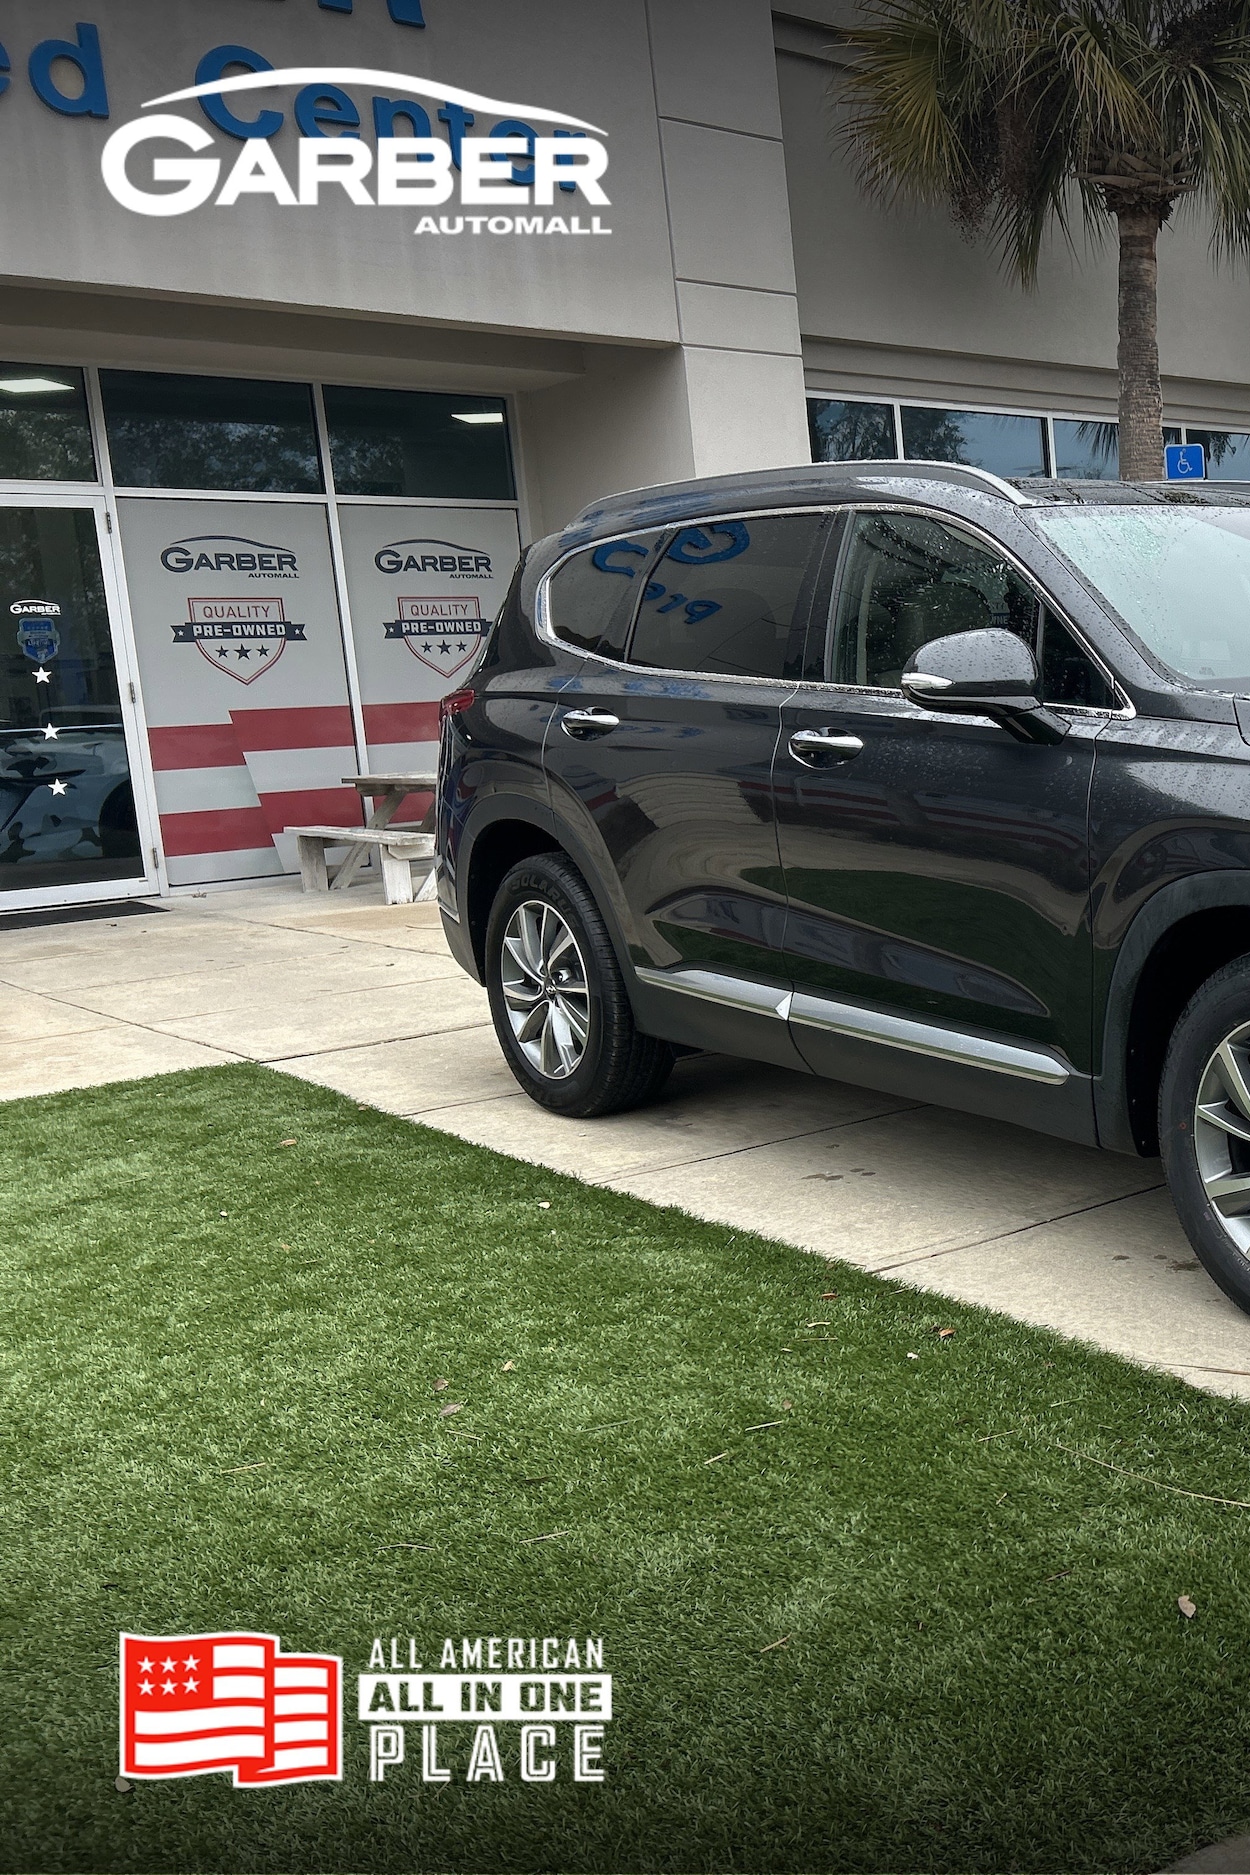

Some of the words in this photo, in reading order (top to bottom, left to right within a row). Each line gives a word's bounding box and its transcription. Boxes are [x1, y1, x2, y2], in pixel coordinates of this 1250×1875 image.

[0, 22, 109, 119] d
[160, 546, 299, 573] GARBER
[374, 549, 493, 574] GARBER
[10, 604, 60, 614] GARBER
[203, 605, 270, 619] QUALITY
[410, 604, 468, 617] QUALITY
[193, 624, 287, 637] PRE-OWNED
[401, 621, 482, 634] PRE-OWNED
